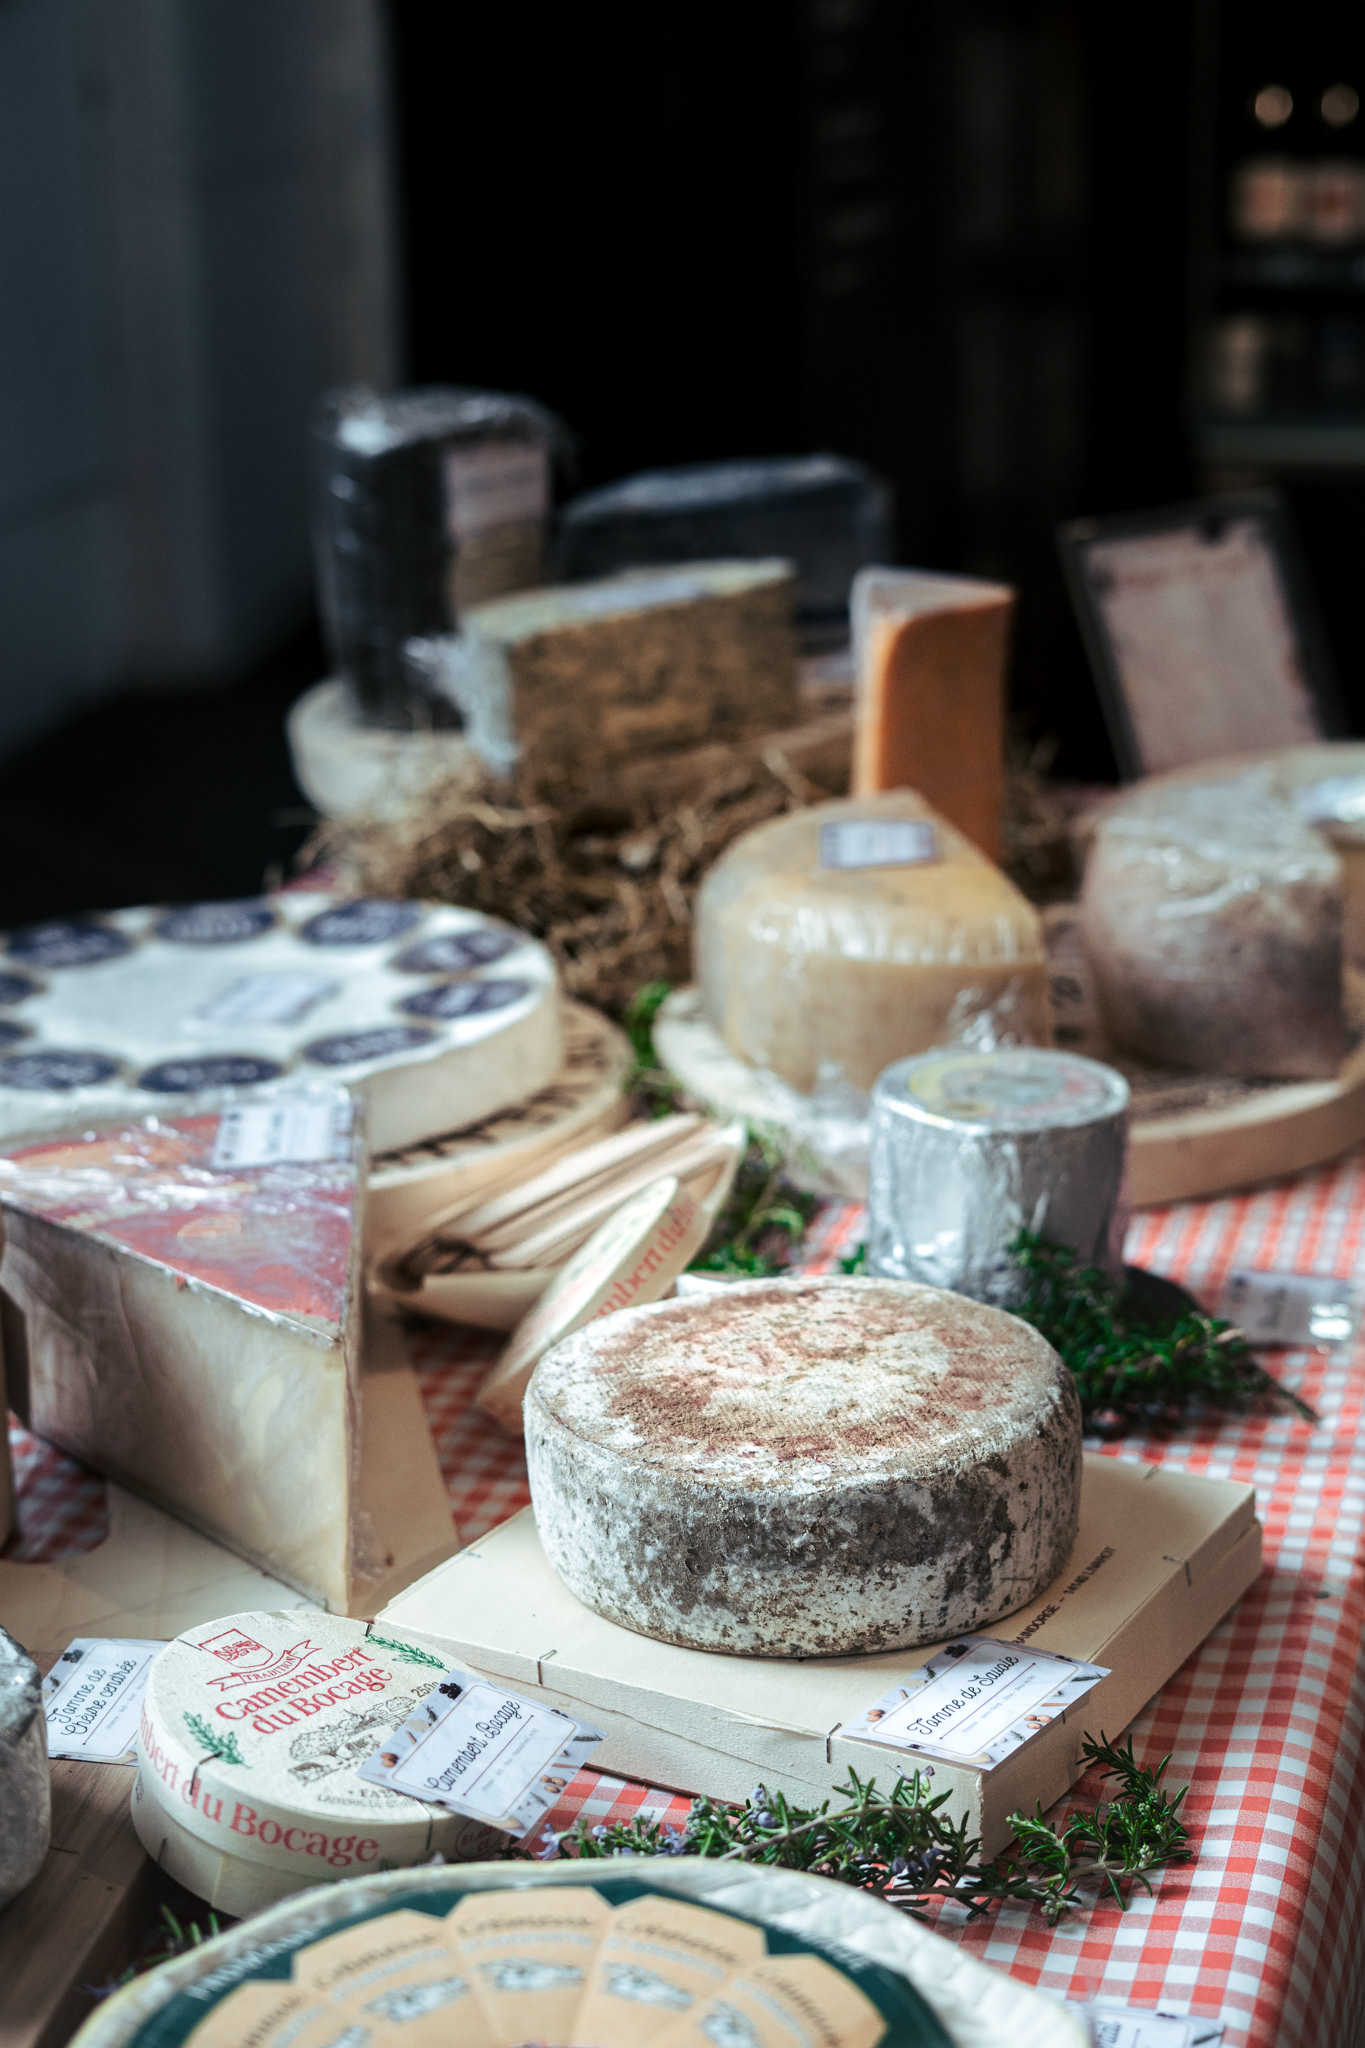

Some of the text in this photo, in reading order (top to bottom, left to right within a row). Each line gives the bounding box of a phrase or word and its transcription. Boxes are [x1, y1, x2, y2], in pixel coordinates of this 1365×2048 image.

[46, 1668, 107, 1724] Tomme de
[60, 1699, 107, 1736] Chèvre
[99, 1660, 137, 1698] cendrée
[215, 1646, 376, 1720] Camembert
[245, 1654, 298, 1681] TRADITION
[252, 1668, 394, 1735] du Bocage
[906, 1655, 1019, 1735] Tomme de Savoie
[423, 1736, 488, 1792] Camembert
[475, 1700, 521, 1740] Bocage
[181, 1776, 224, 1823] du
[228, 1801, 379, 1867] Bocage
